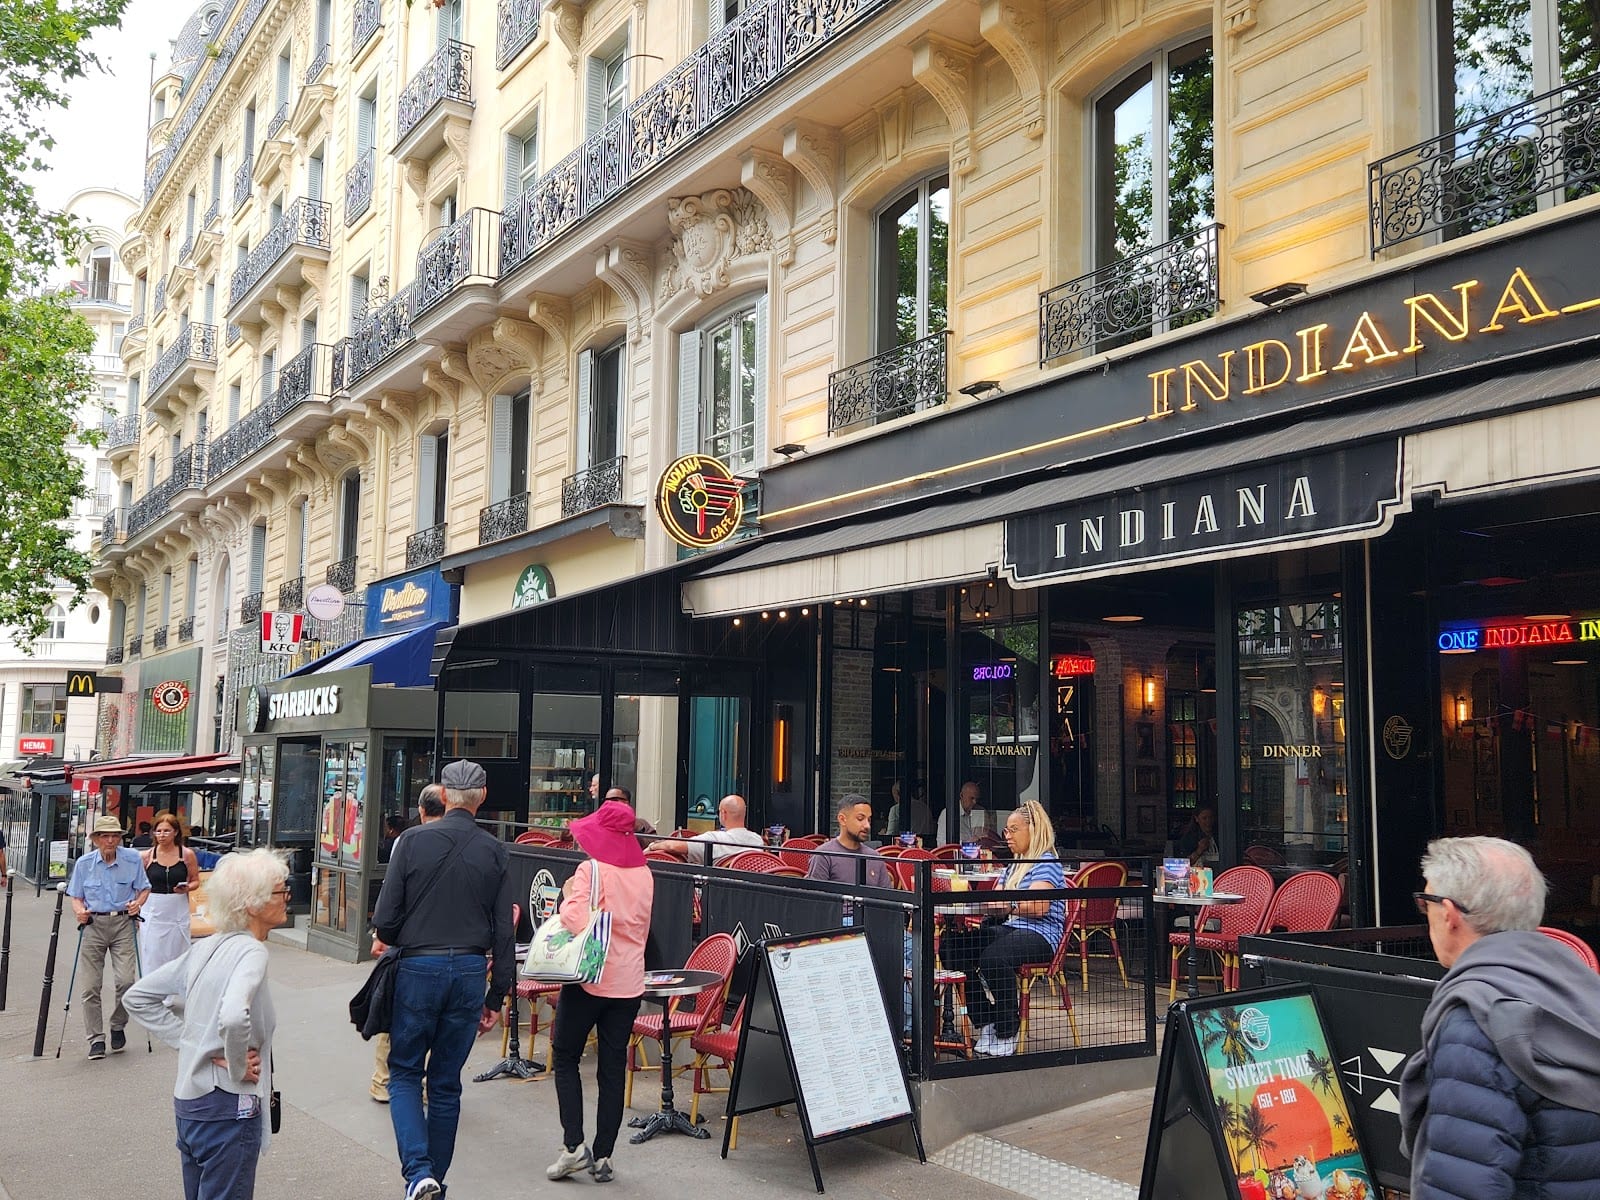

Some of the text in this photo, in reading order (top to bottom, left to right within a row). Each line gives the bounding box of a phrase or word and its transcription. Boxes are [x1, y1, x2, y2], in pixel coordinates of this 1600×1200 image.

[1148, 267, 1559, 419] INDIANA
[665, 457, 702, 492] INDIANA
[1053, 476, 1318, 558] INDIANA
[269, 643, 295, 652] KFC
[1439, 631, 1478, 649] ONE
[1485, 623, 1573, 646] INDIANA
[155, 682, 186, 698] CHIPOTLE
[268, 685, 338, 720] STARBUCKS
[23, 740, 46, 750] HEMA
[972, 745, 1032, 756] RESTAURANT
[1263, 745, 1321, 757] DINNER
[1225, 1054, 1313, 1089] SWEET TIME
